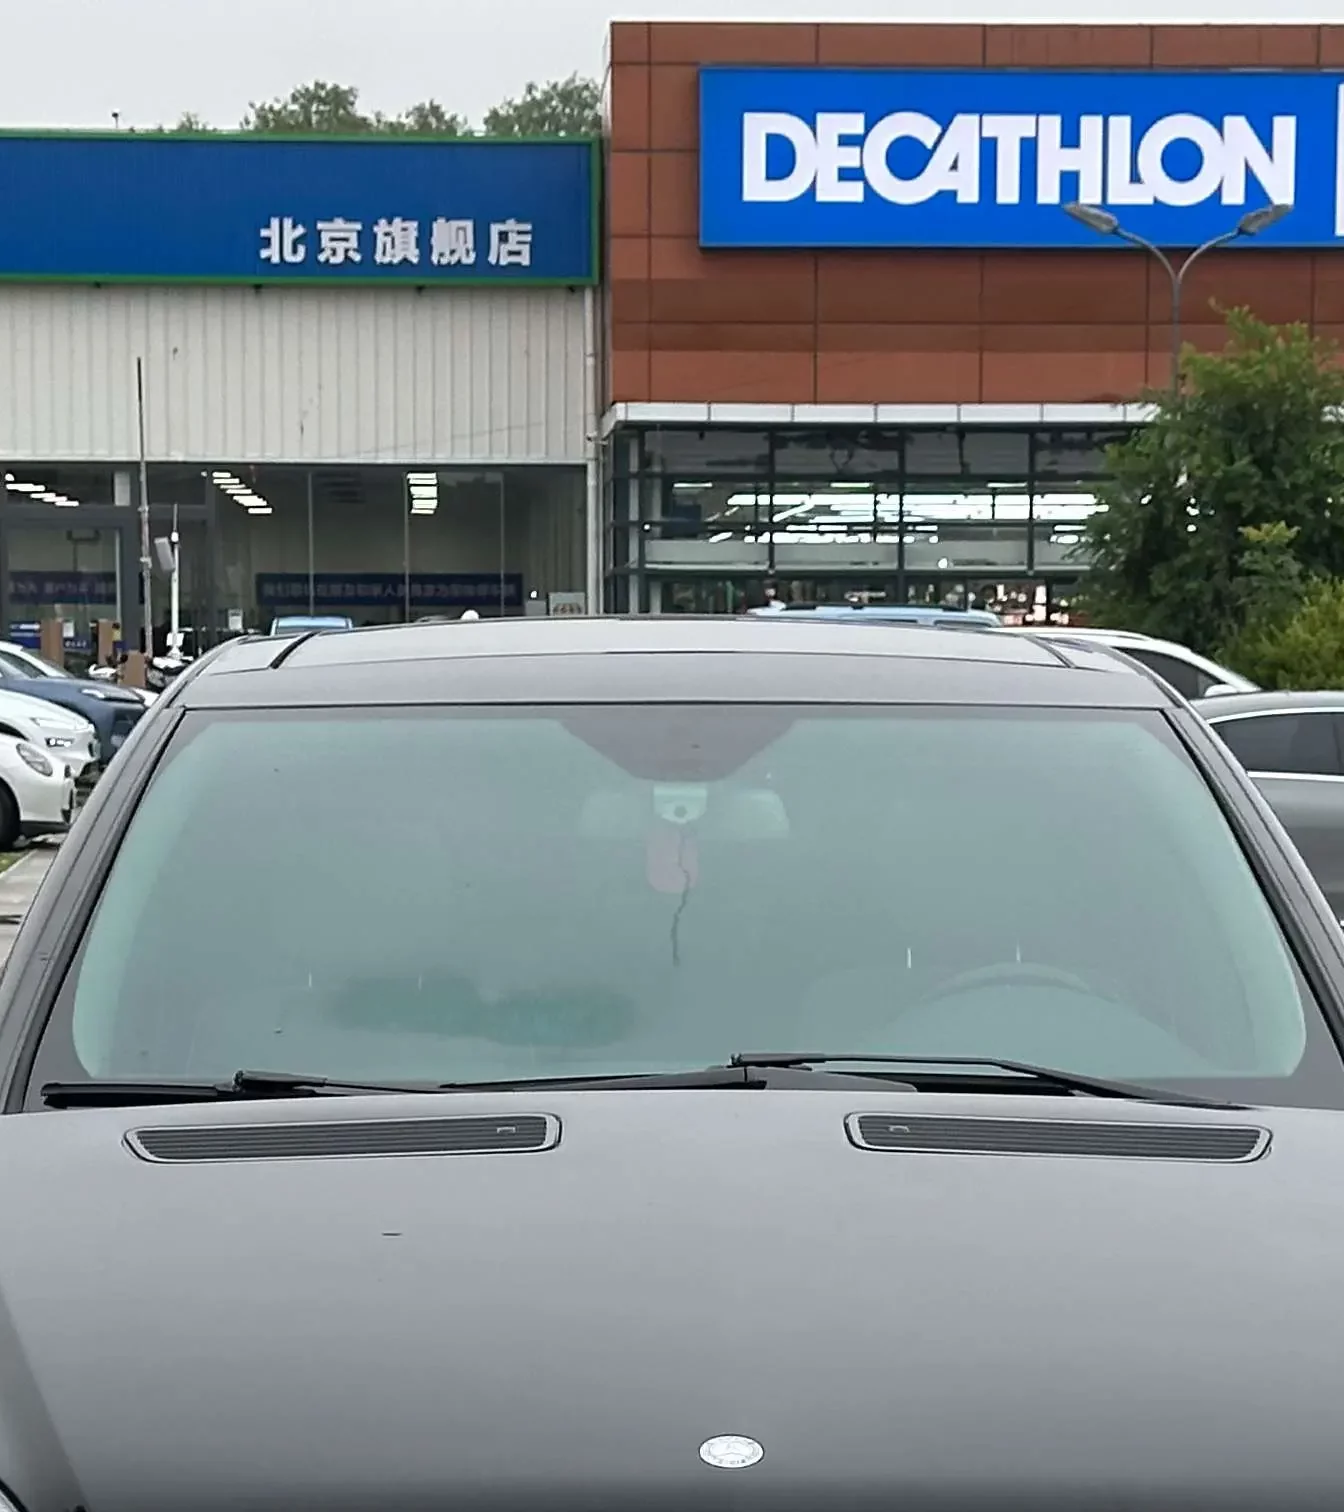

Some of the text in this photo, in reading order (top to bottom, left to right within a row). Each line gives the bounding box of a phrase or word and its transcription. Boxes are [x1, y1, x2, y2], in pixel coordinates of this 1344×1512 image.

[742, 111, 1297, 205] DECATHLON
[259, 216, 533, 266] 北京旗舰店
